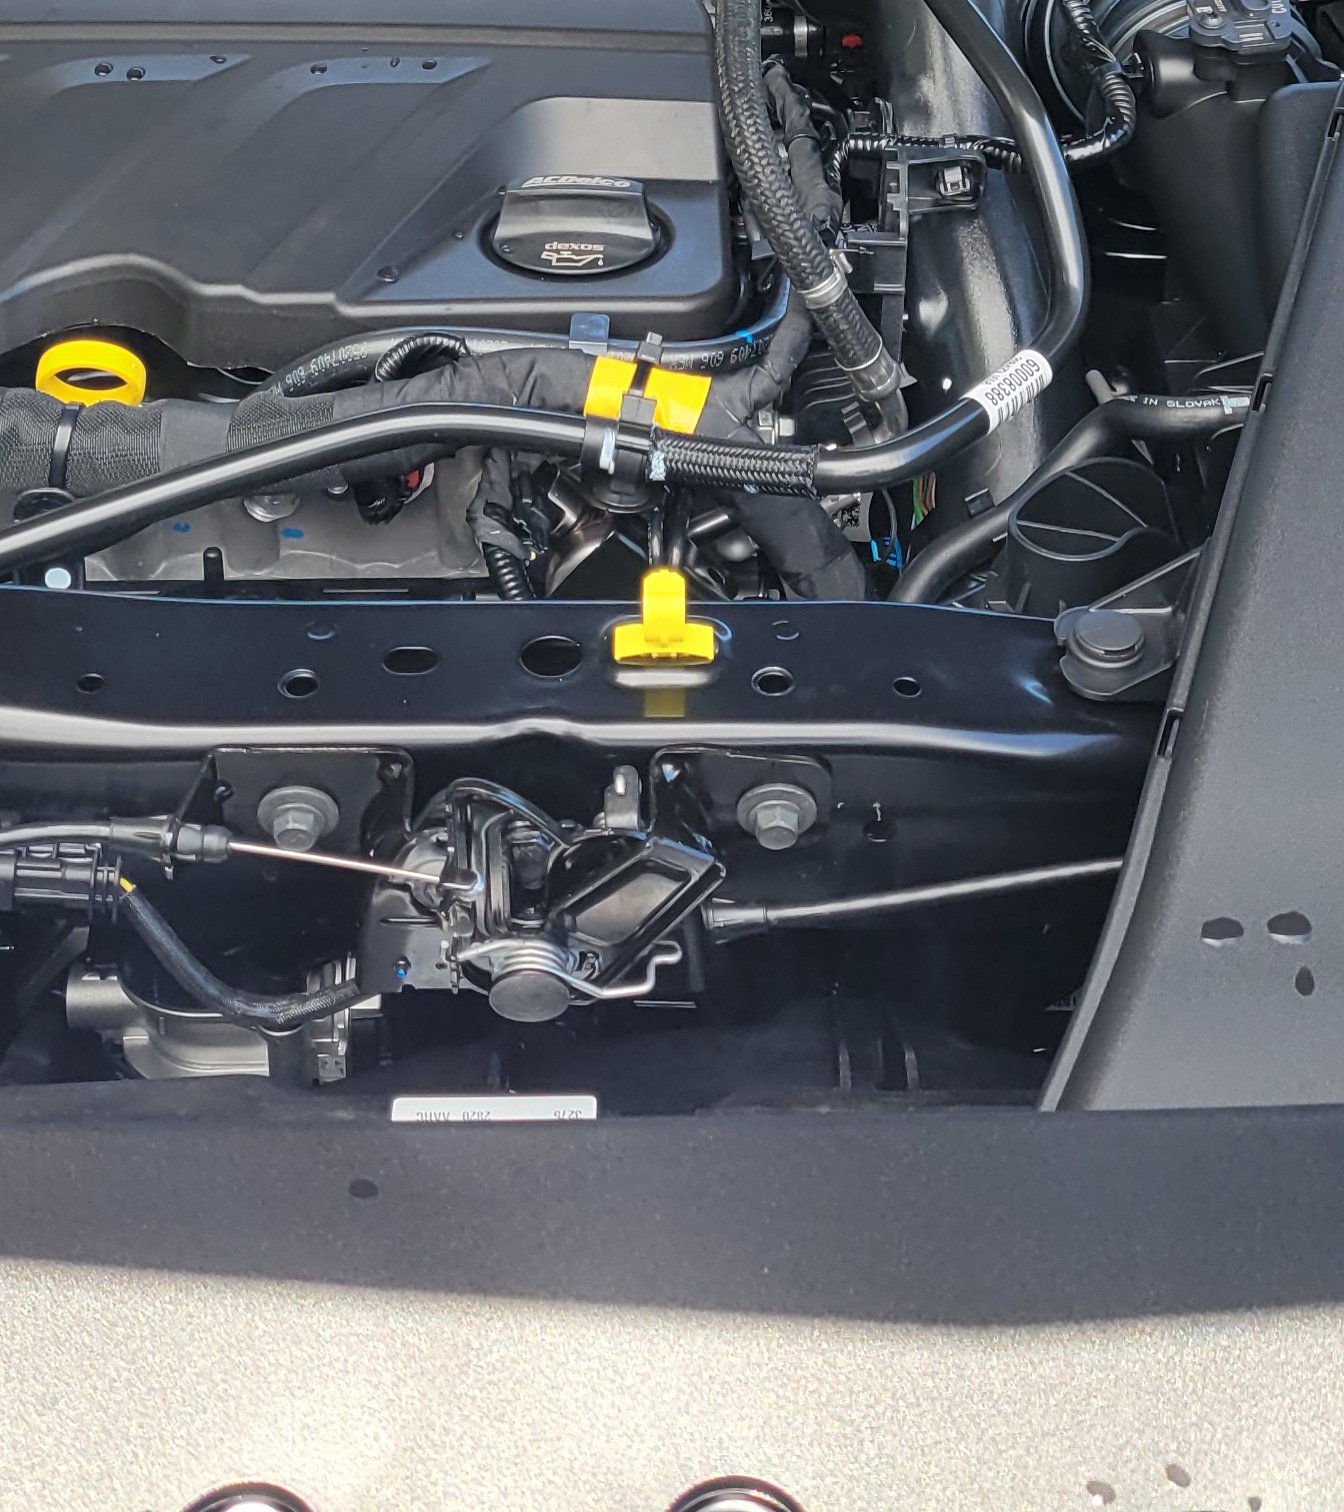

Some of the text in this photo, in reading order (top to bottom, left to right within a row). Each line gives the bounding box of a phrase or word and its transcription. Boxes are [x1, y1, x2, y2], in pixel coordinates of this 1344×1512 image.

[521, 175, 631, 189] ACDelco
[544, 241, 606, 252] dexos
[1142, 397, 1159, 407] IN
